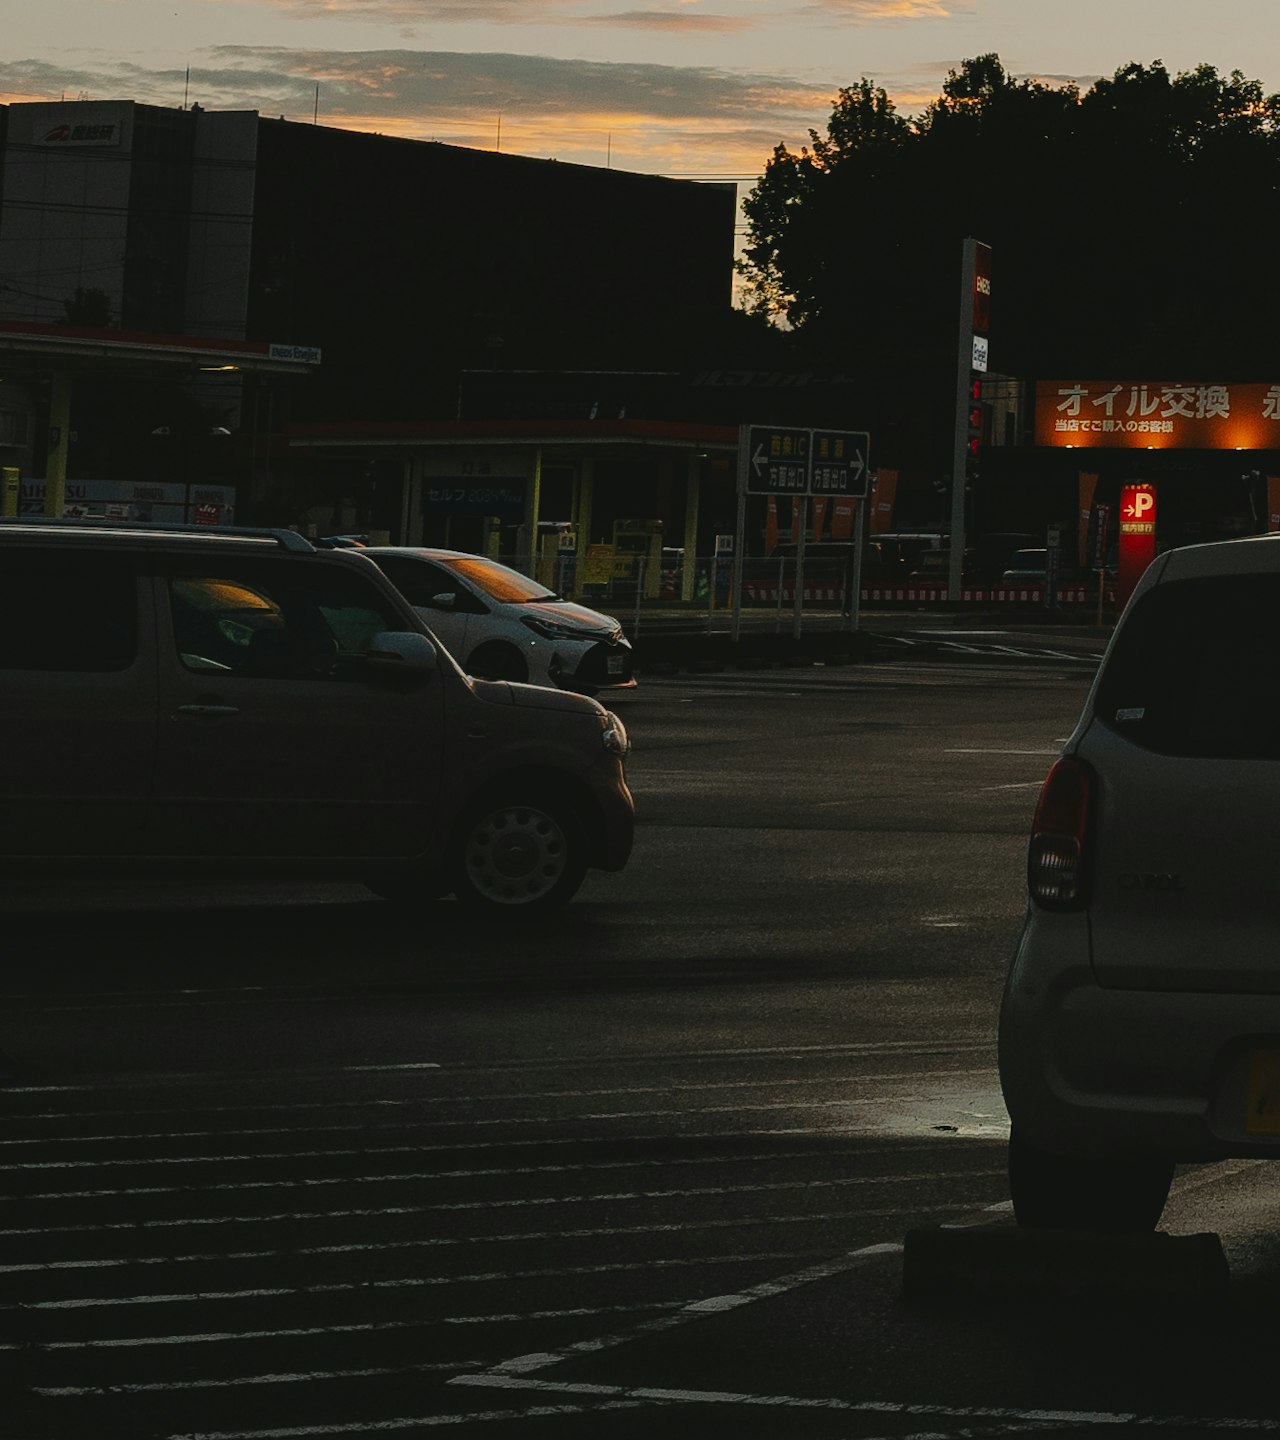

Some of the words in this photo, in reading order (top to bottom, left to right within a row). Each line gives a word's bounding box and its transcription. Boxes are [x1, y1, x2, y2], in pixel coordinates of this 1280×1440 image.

[1057, 385, 1231, 418] オイル交換
[1055, 420, 1173, 433] 当店でご購入のお客様
[769, 465, 805, 488] 方面出口
[814, 467, 847, 489] 方面出口
[429, 488, 466, 501] セルフ
[1135, 492, 1153, 517] P
